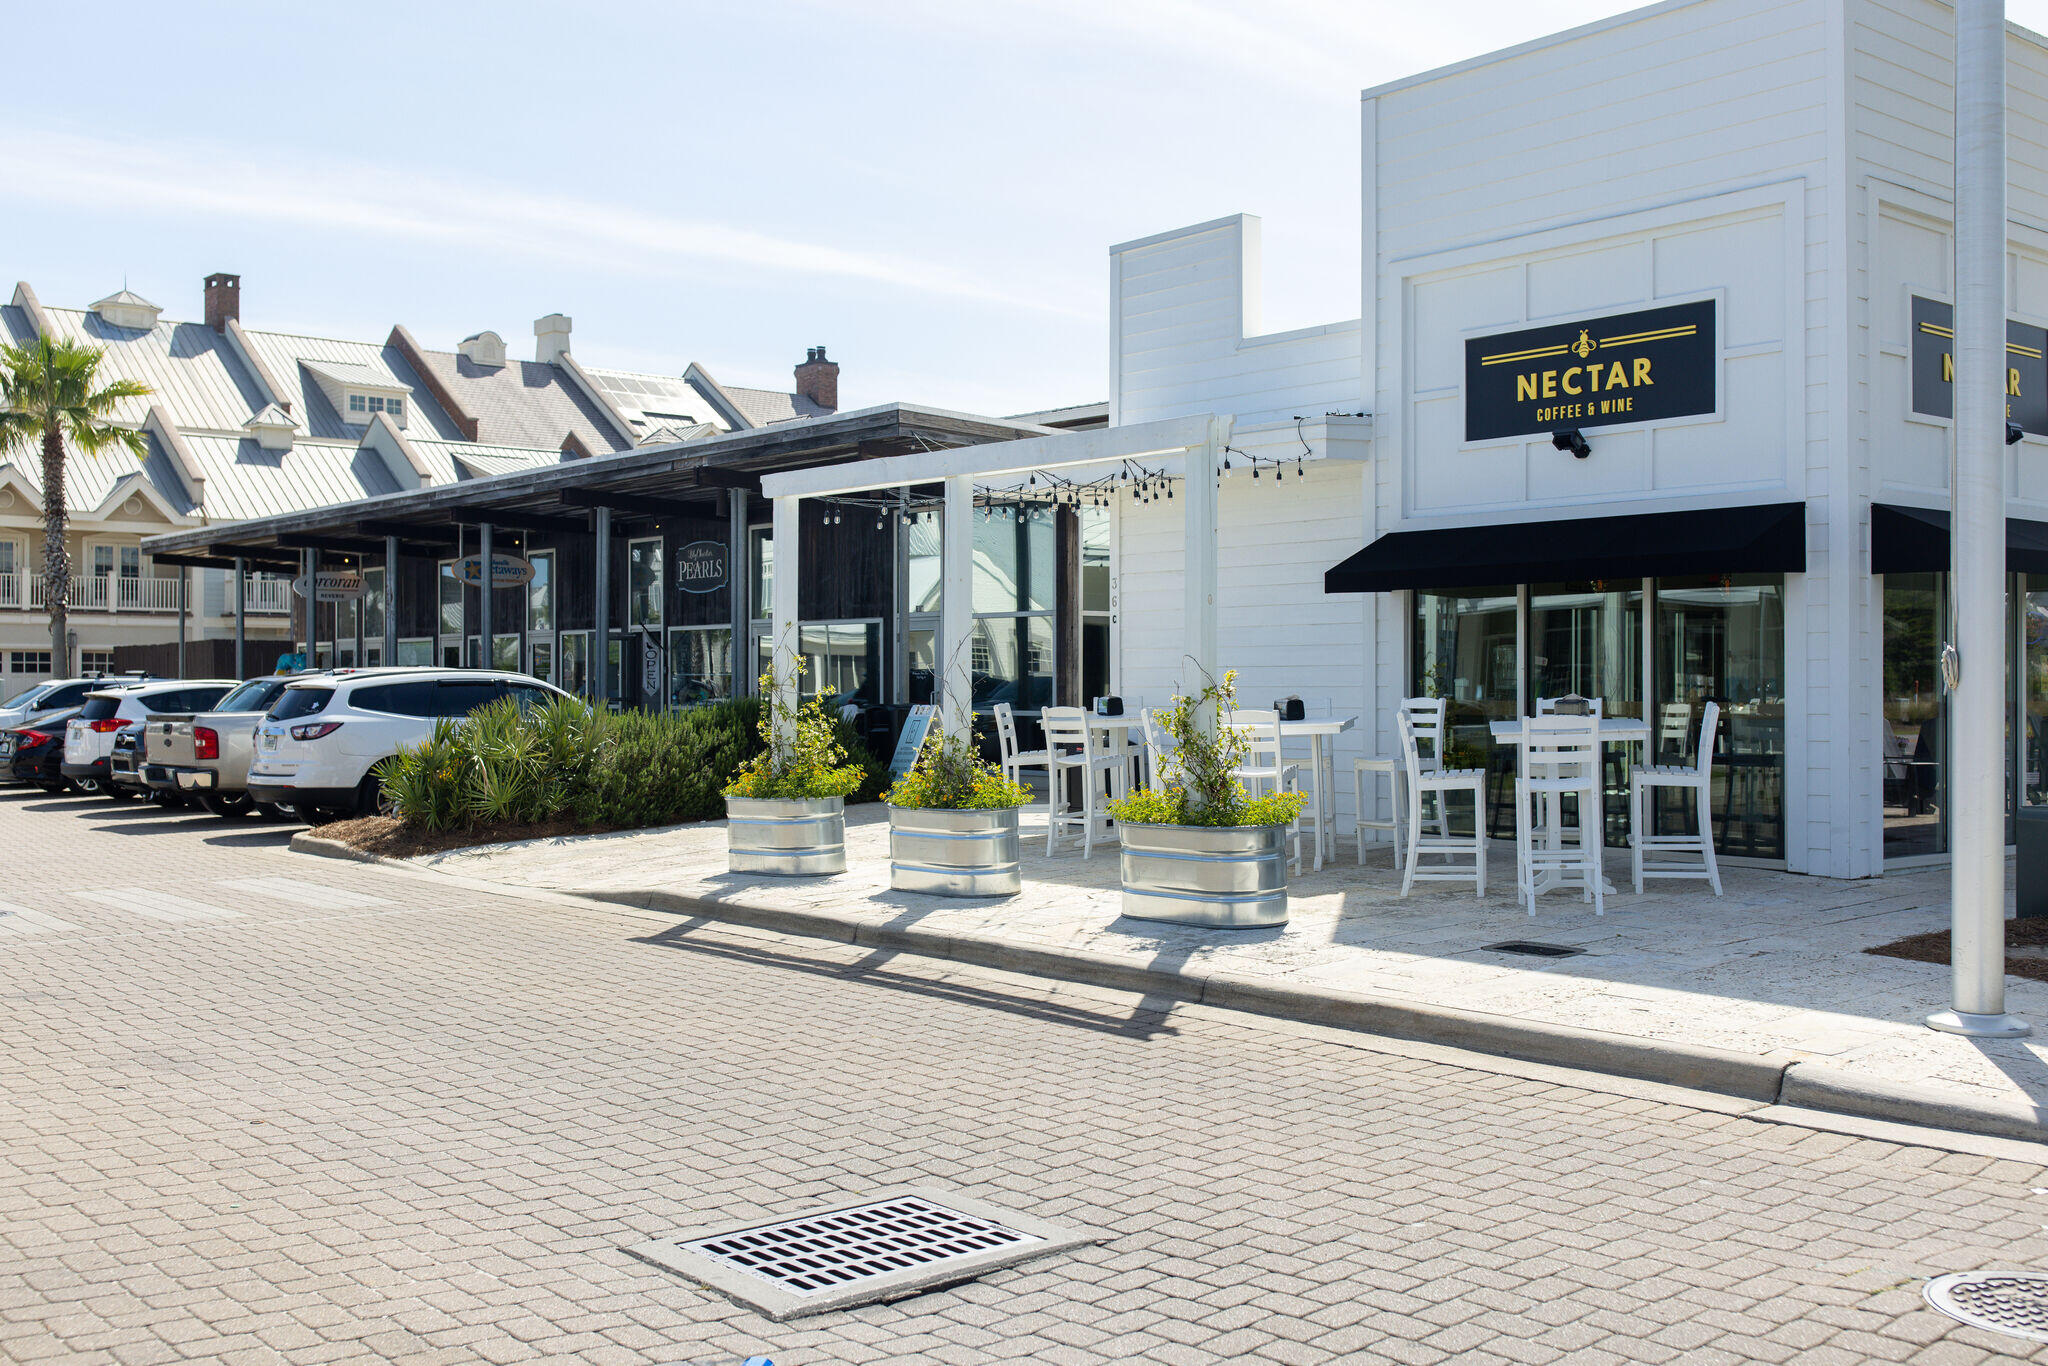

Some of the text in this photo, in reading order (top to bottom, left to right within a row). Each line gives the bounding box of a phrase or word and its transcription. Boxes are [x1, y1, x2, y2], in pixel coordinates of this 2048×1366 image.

[1517, 357, 1654, 402] NECTAR
[1537, 397, 1633, 422] COFFEE & WINE
[679, 559, 722, 581] PEARLS
[645, 650, 658, 690] OPEN
